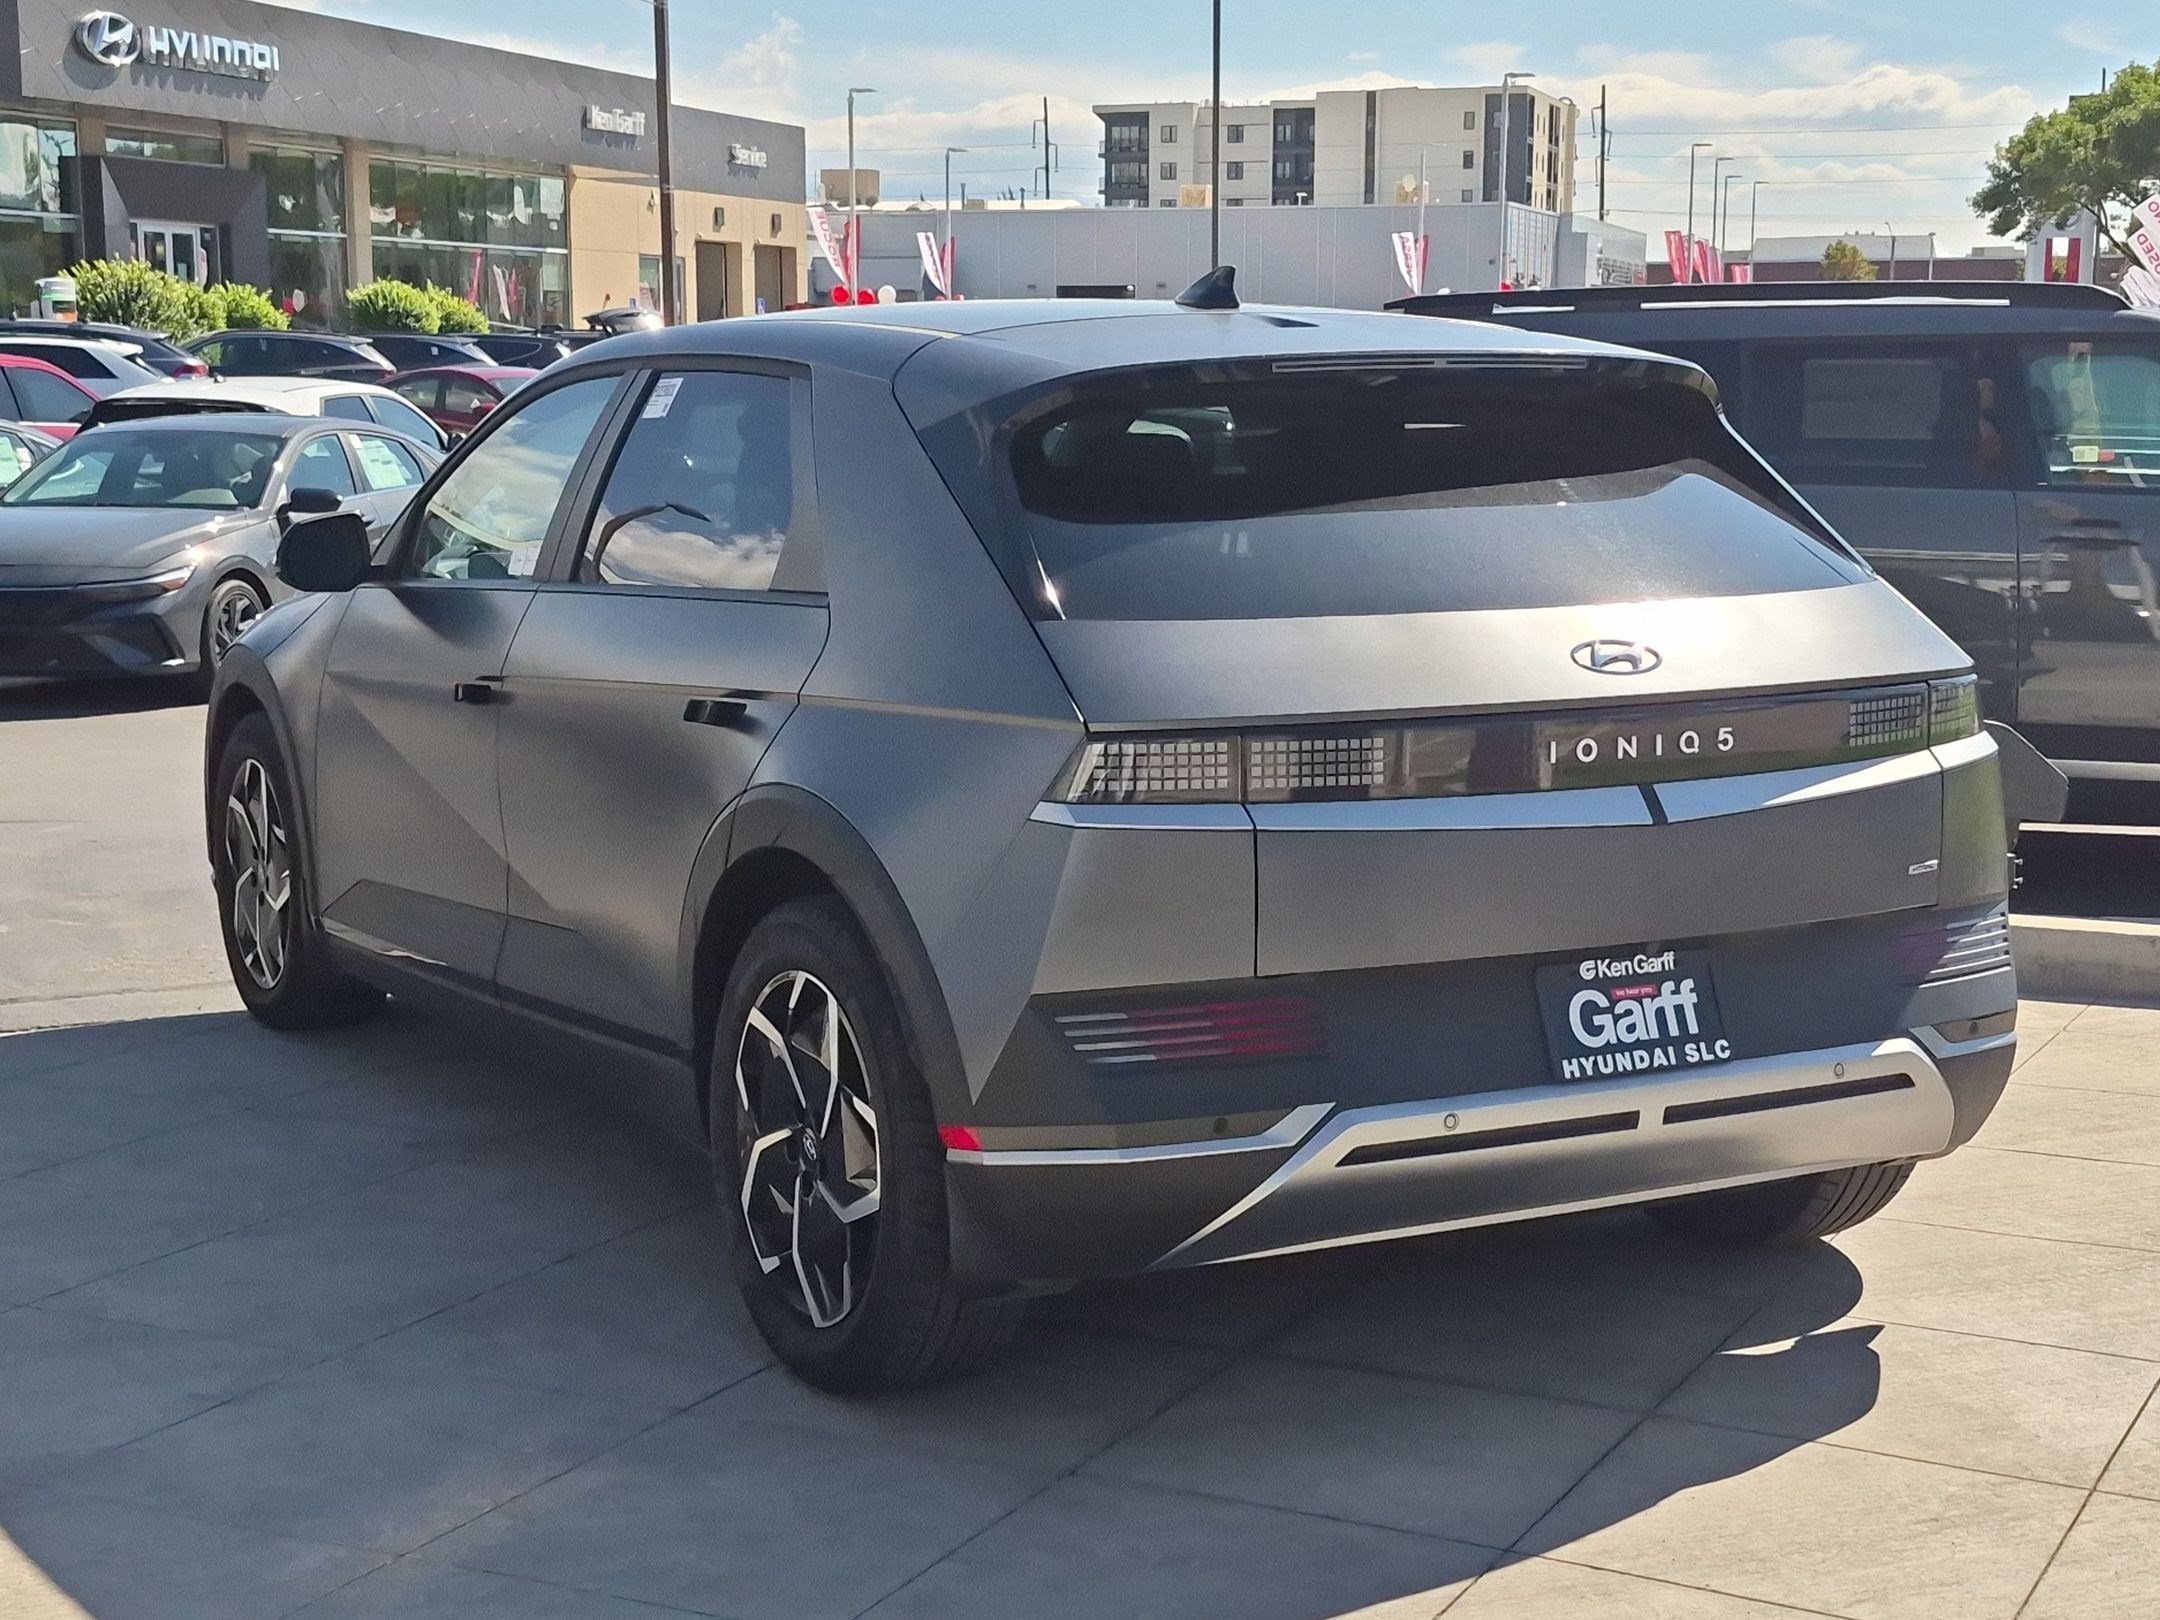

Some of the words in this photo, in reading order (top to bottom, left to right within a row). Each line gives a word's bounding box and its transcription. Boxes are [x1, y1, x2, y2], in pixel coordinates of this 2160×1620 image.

[148, 25, 280, 72] HYUNDAI
[1549, 730, 1700, 764] IONIQ
[1717, 727, 1735, 751] 5
[1568, 978, 1699, 1048] Garff
[1562, 1046, 1677, 1079] HYUNDAI
[1684, 1039, 1731, 1063] SLC
